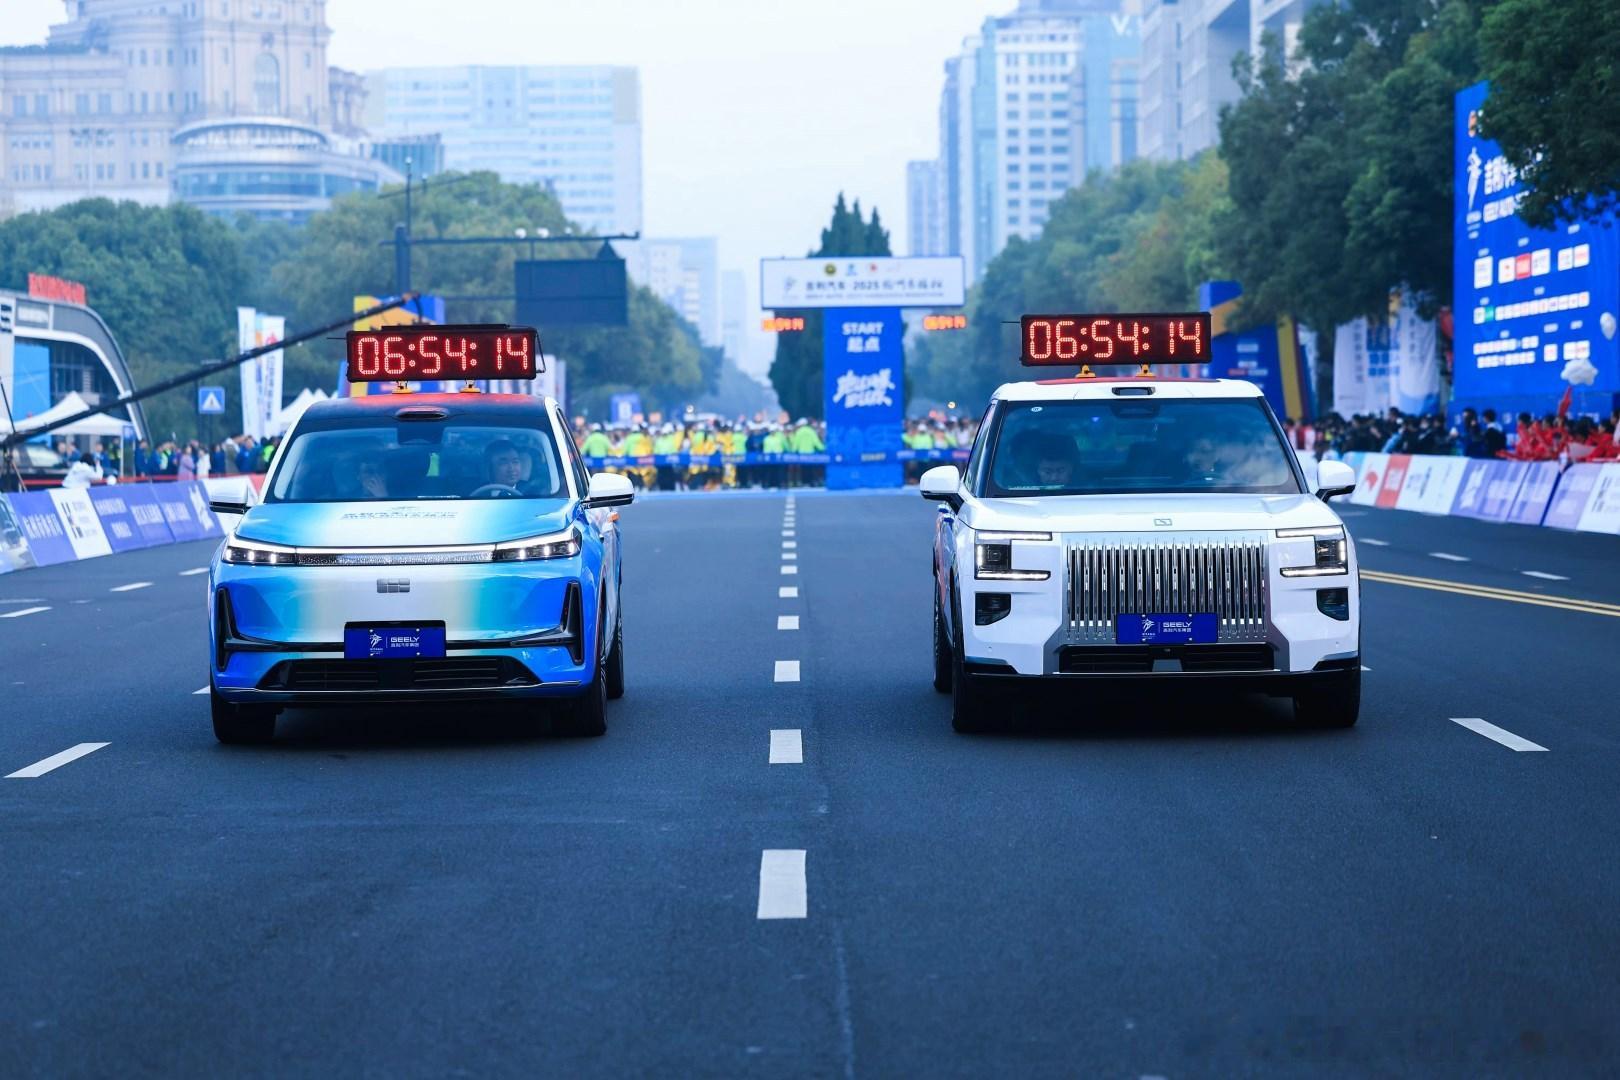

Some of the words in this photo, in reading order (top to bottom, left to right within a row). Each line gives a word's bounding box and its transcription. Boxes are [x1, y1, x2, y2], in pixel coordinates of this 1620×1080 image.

[842, 321, 884, 335] START
[1028, 320, 1201, 360] 06:54:14
[357, 335, 528, 376] 06:54:14
